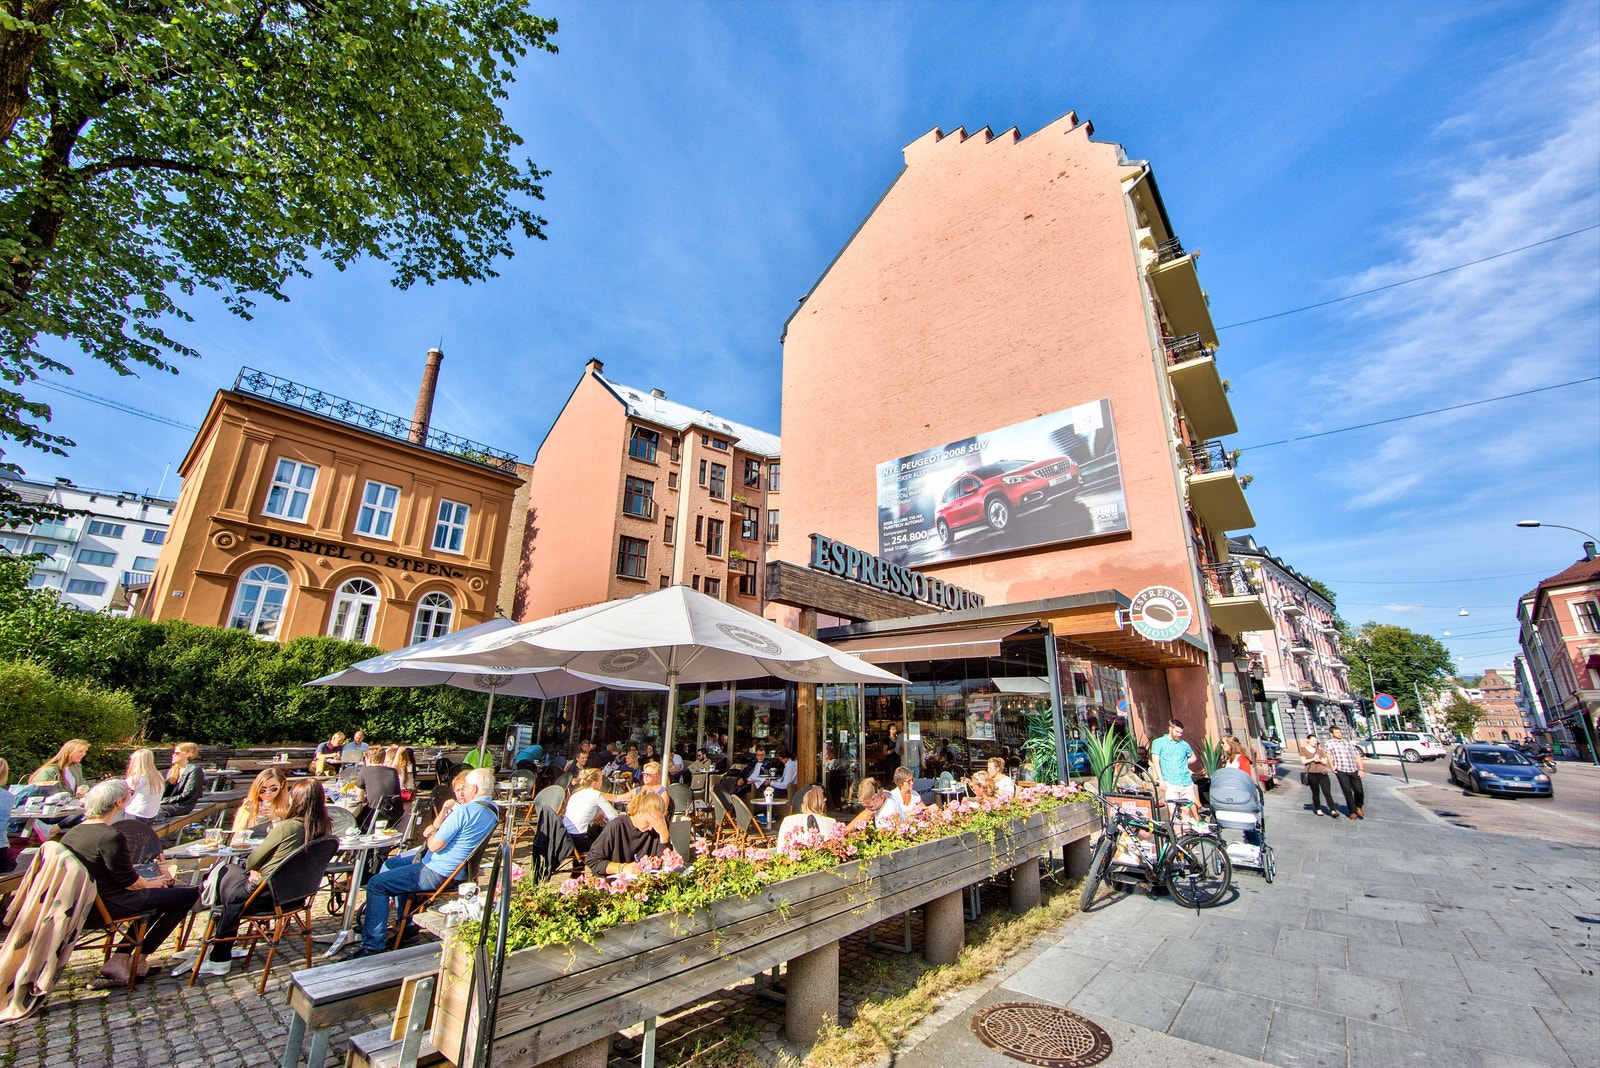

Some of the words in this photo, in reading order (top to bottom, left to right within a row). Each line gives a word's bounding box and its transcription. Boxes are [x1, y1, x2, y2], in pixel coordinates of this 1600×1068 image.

[882, 465, 899, 477] NYE
[900, 453, 942, 472] PEUGEOT
[943, 446, 967, 460] 2008
[968, 440, 989, 453] SUV
[266, 533, 351, 560] BERTEL
[361, 552, 379, 565] O.
[386, 556, 453, 578] STEEN
[808, 533, 928, 601] ESPRESSO
[1134, 589, 1184, 611] ESPRESSO
[1142, 622, 1182, 638] HOUSE
